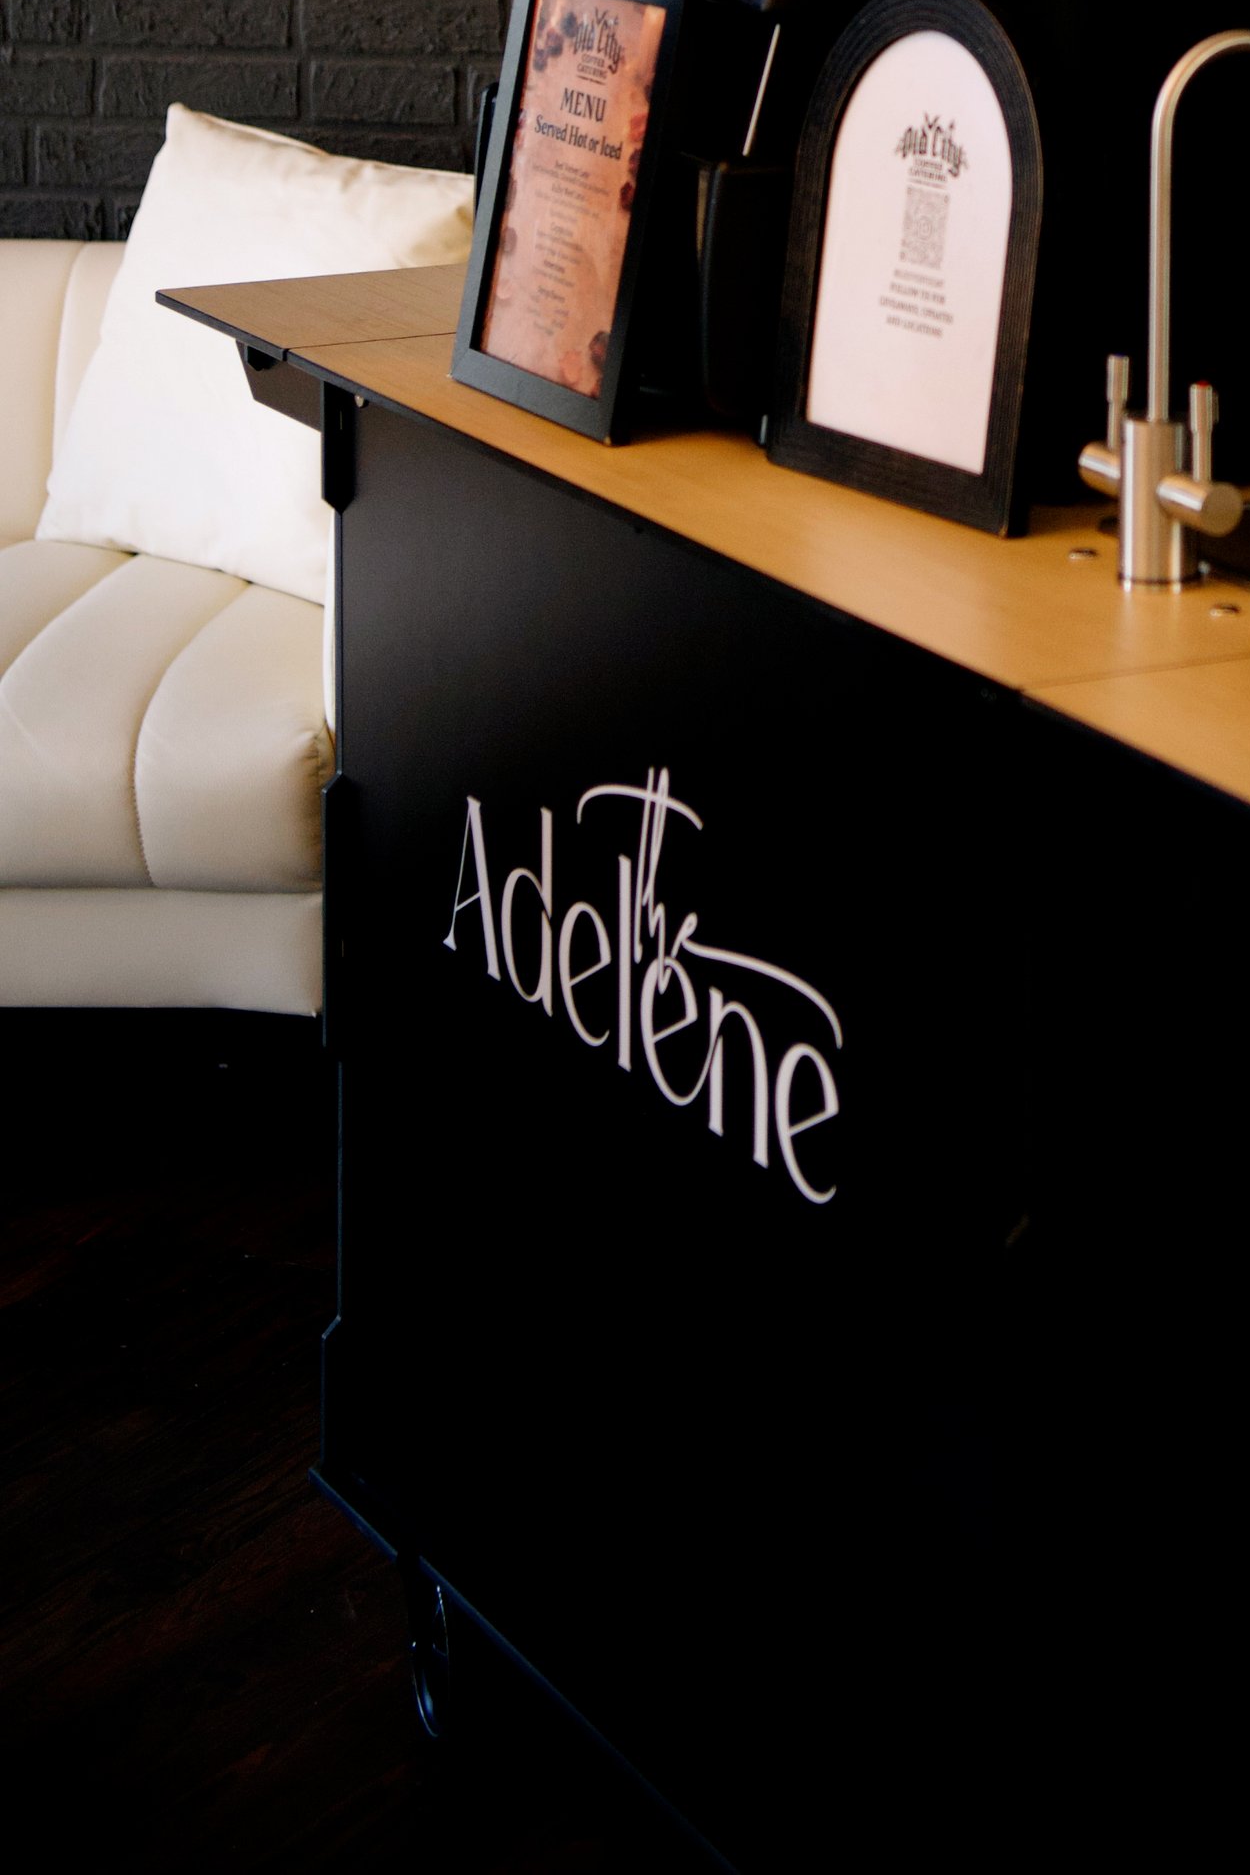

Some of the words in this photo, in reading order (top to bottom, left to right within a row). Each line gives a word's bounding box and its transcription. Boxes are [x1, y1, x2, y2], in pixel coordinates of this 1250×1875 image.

[573, 19, 595, 55] Old
[597, 14, 622, 75] City
[560, 87, 606, 122] MENU
[534, 114, 568, 142] Served
[568, 125, 588, 149] Hot
[588, 137, 600, 154] or
[600, 135, 623, 160] Iced
[901, 126, 927, 159] Old
[931, 119, 963, 178] City
[442, 795, 840, 1205] Adelene
